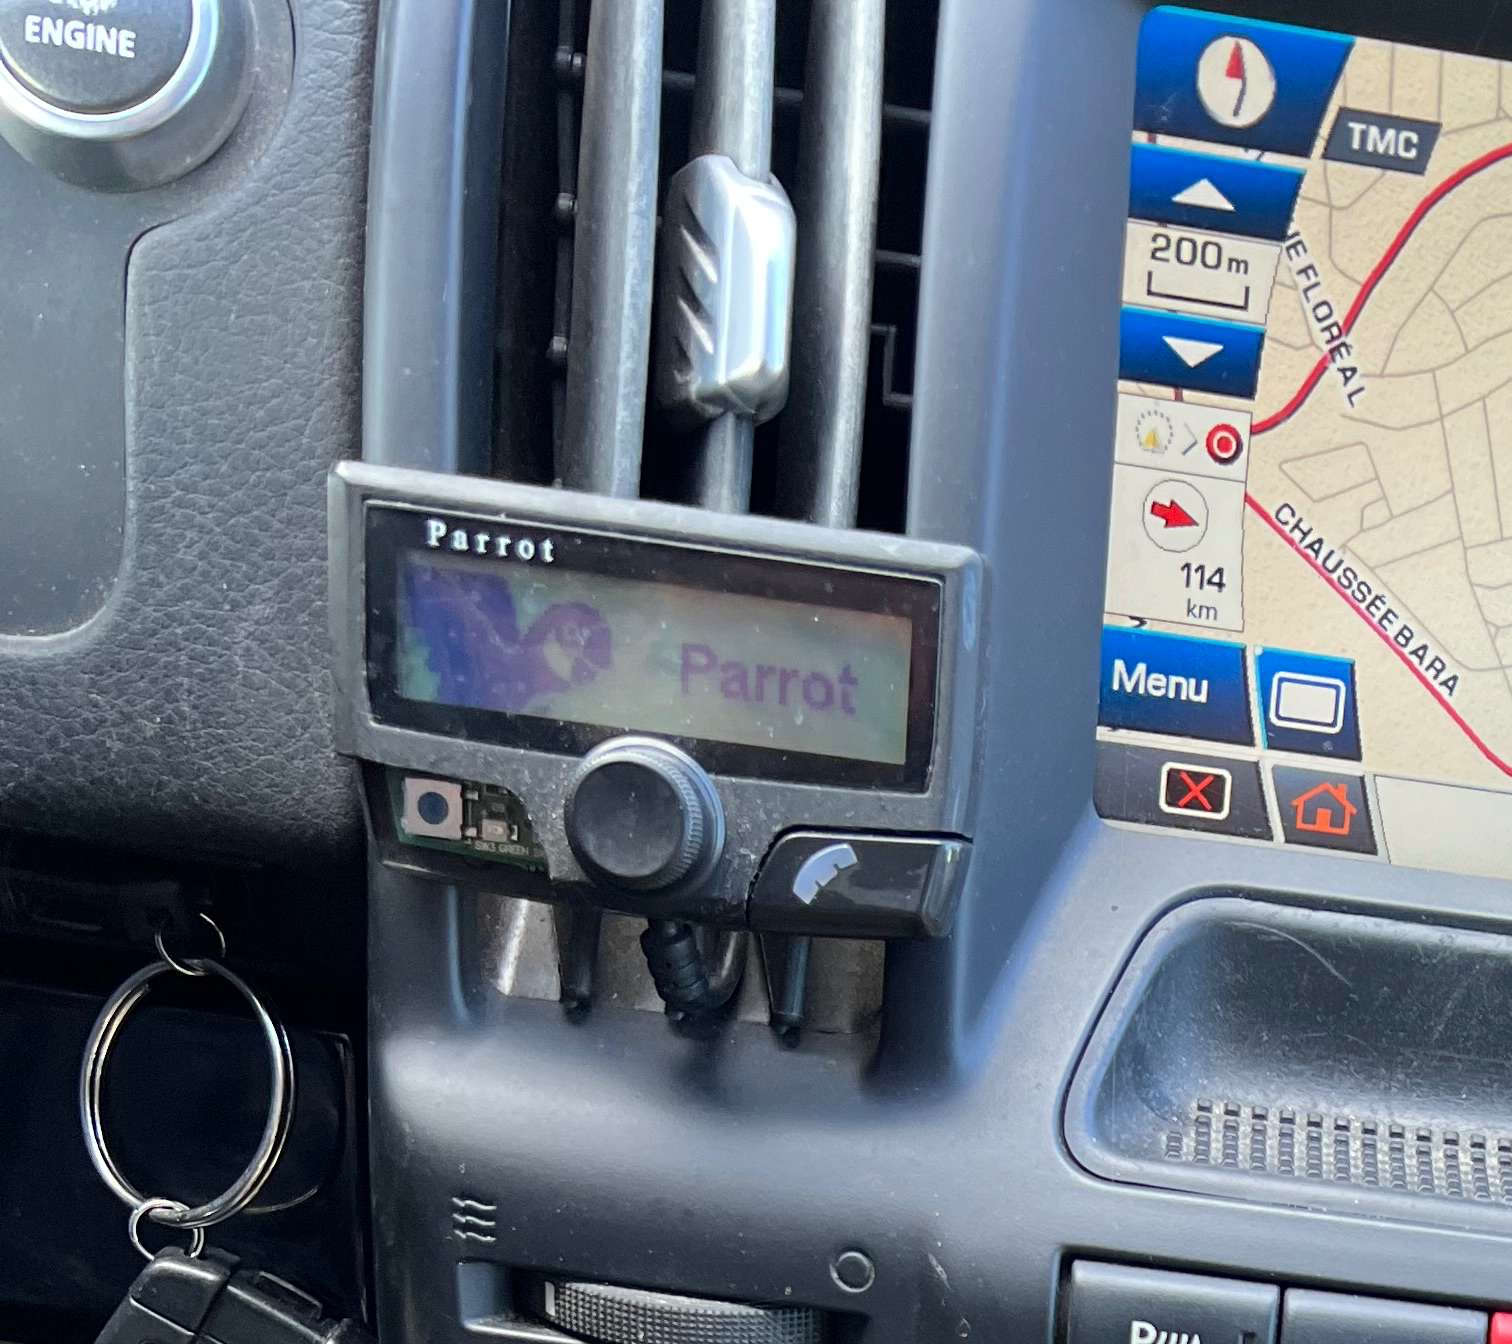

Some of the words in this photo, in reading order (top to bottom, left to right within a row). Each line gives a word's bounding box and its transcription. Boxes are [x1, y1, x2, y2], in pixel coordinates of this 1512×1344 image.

[25, 15, 136, 58] ENGINE
[1348, 121, 1419, 159] TMC
[1150, 233, 1223, 271] 200
[1227, 258, 1249, 275] m
[1296, 264, 1365, 408] FLORÉAL
[425, 518, 556, 563] Parrot
[1180, 562, 1226, 593] 114
[1187, 598, 1218, 621] km
[1274, 503, 1399, 632] CHAUSSÉE
[1393, 624, 1461, 697] BARA
[680, 642, 860, 716] Parrot
[1112, 658, 1209, 704] Menu
